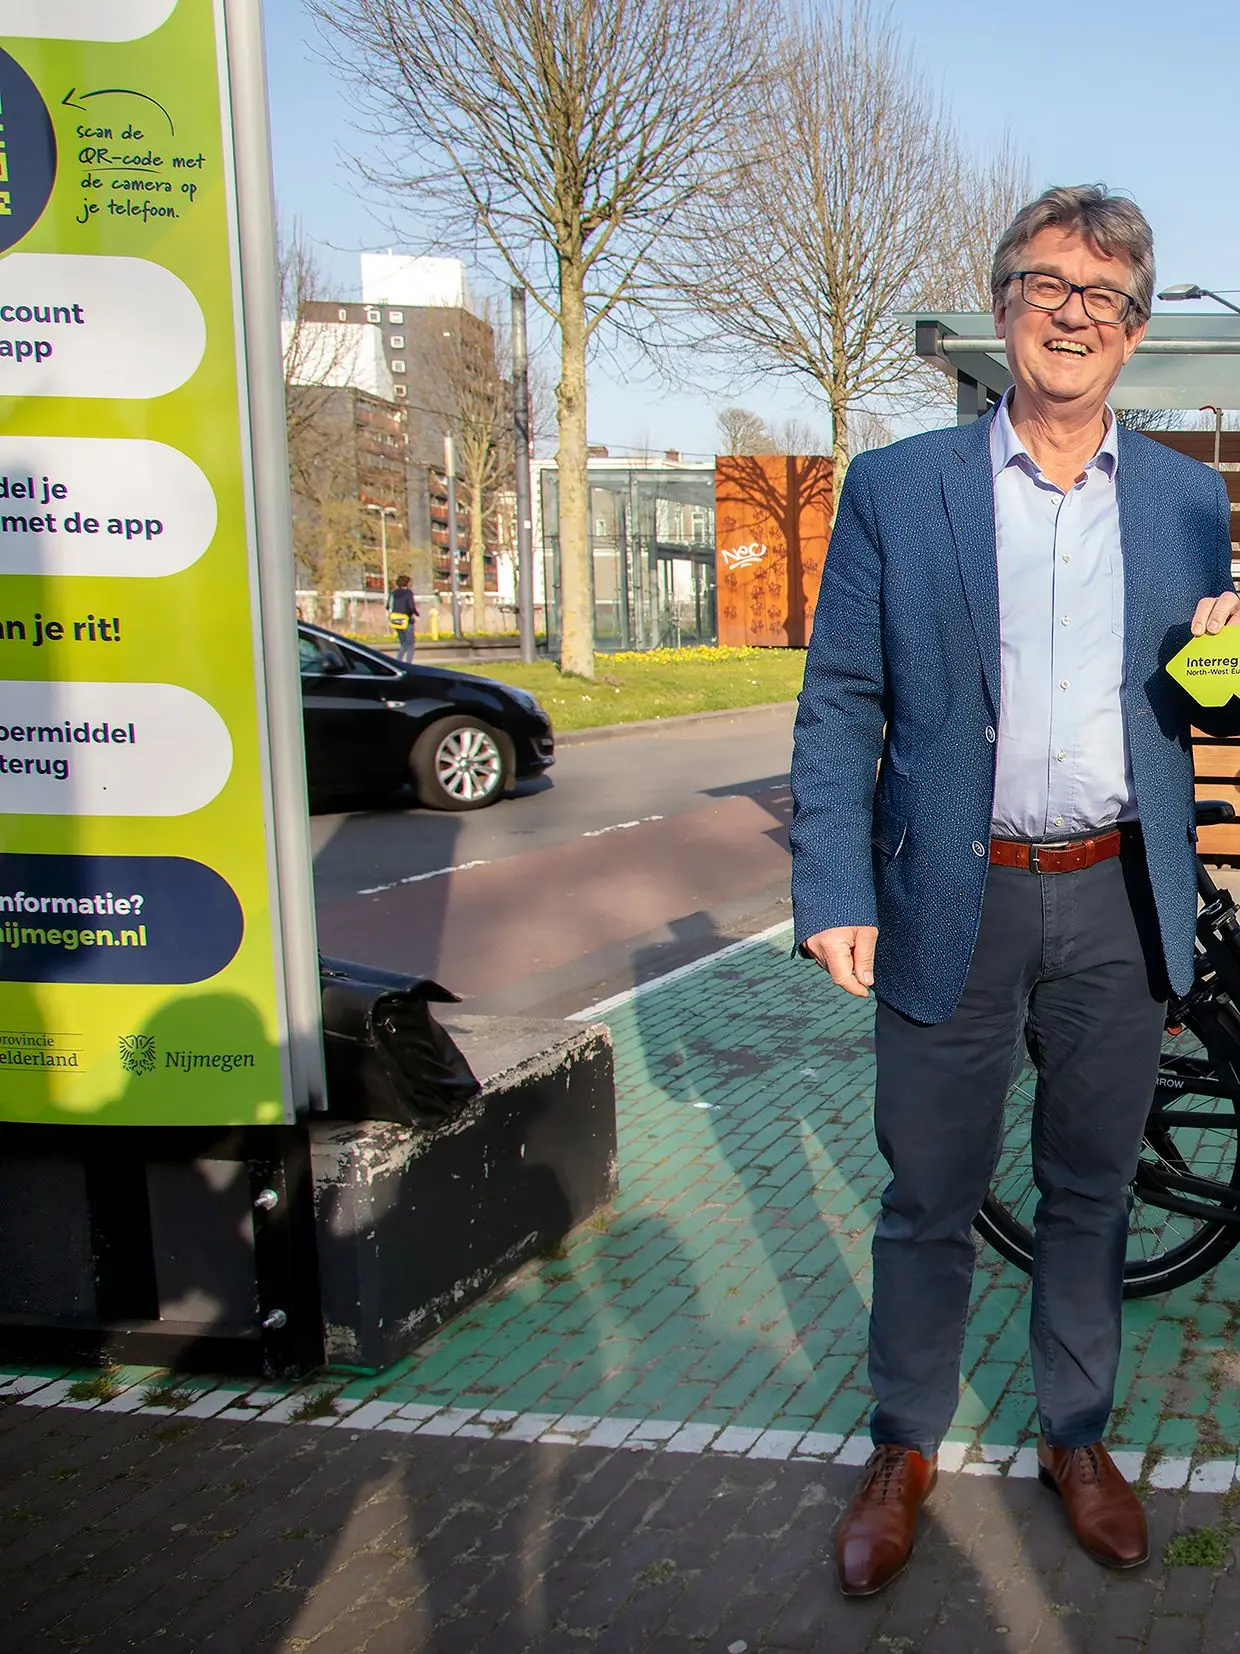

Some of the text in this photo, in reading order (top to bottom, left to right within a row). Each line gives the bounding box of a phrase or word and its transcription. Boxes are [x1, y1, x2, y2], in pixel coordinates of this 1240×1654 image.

[76, 124, 144, 140] scan de
[78, 147, 207, 169] QR-code met
[81, 173, 197, 201] de camera op
[76, 200, 180, 223] je telefoon.
[0, 302, 85, 324] count
[0, 339, 53, 362] app
[41, 476, 68, 504] je
[1, 512, 164, 540] met de app
[32, 613, 65, 647] je
[73, 614, 121, 642] rit!
[1186, 656, 1239, 668] Interreg
[1186, 668, 1229, 676] North-West
[0, 1033, 54, 1047] rovincie
[165, 1051, 255, 1073] Nijmegen
